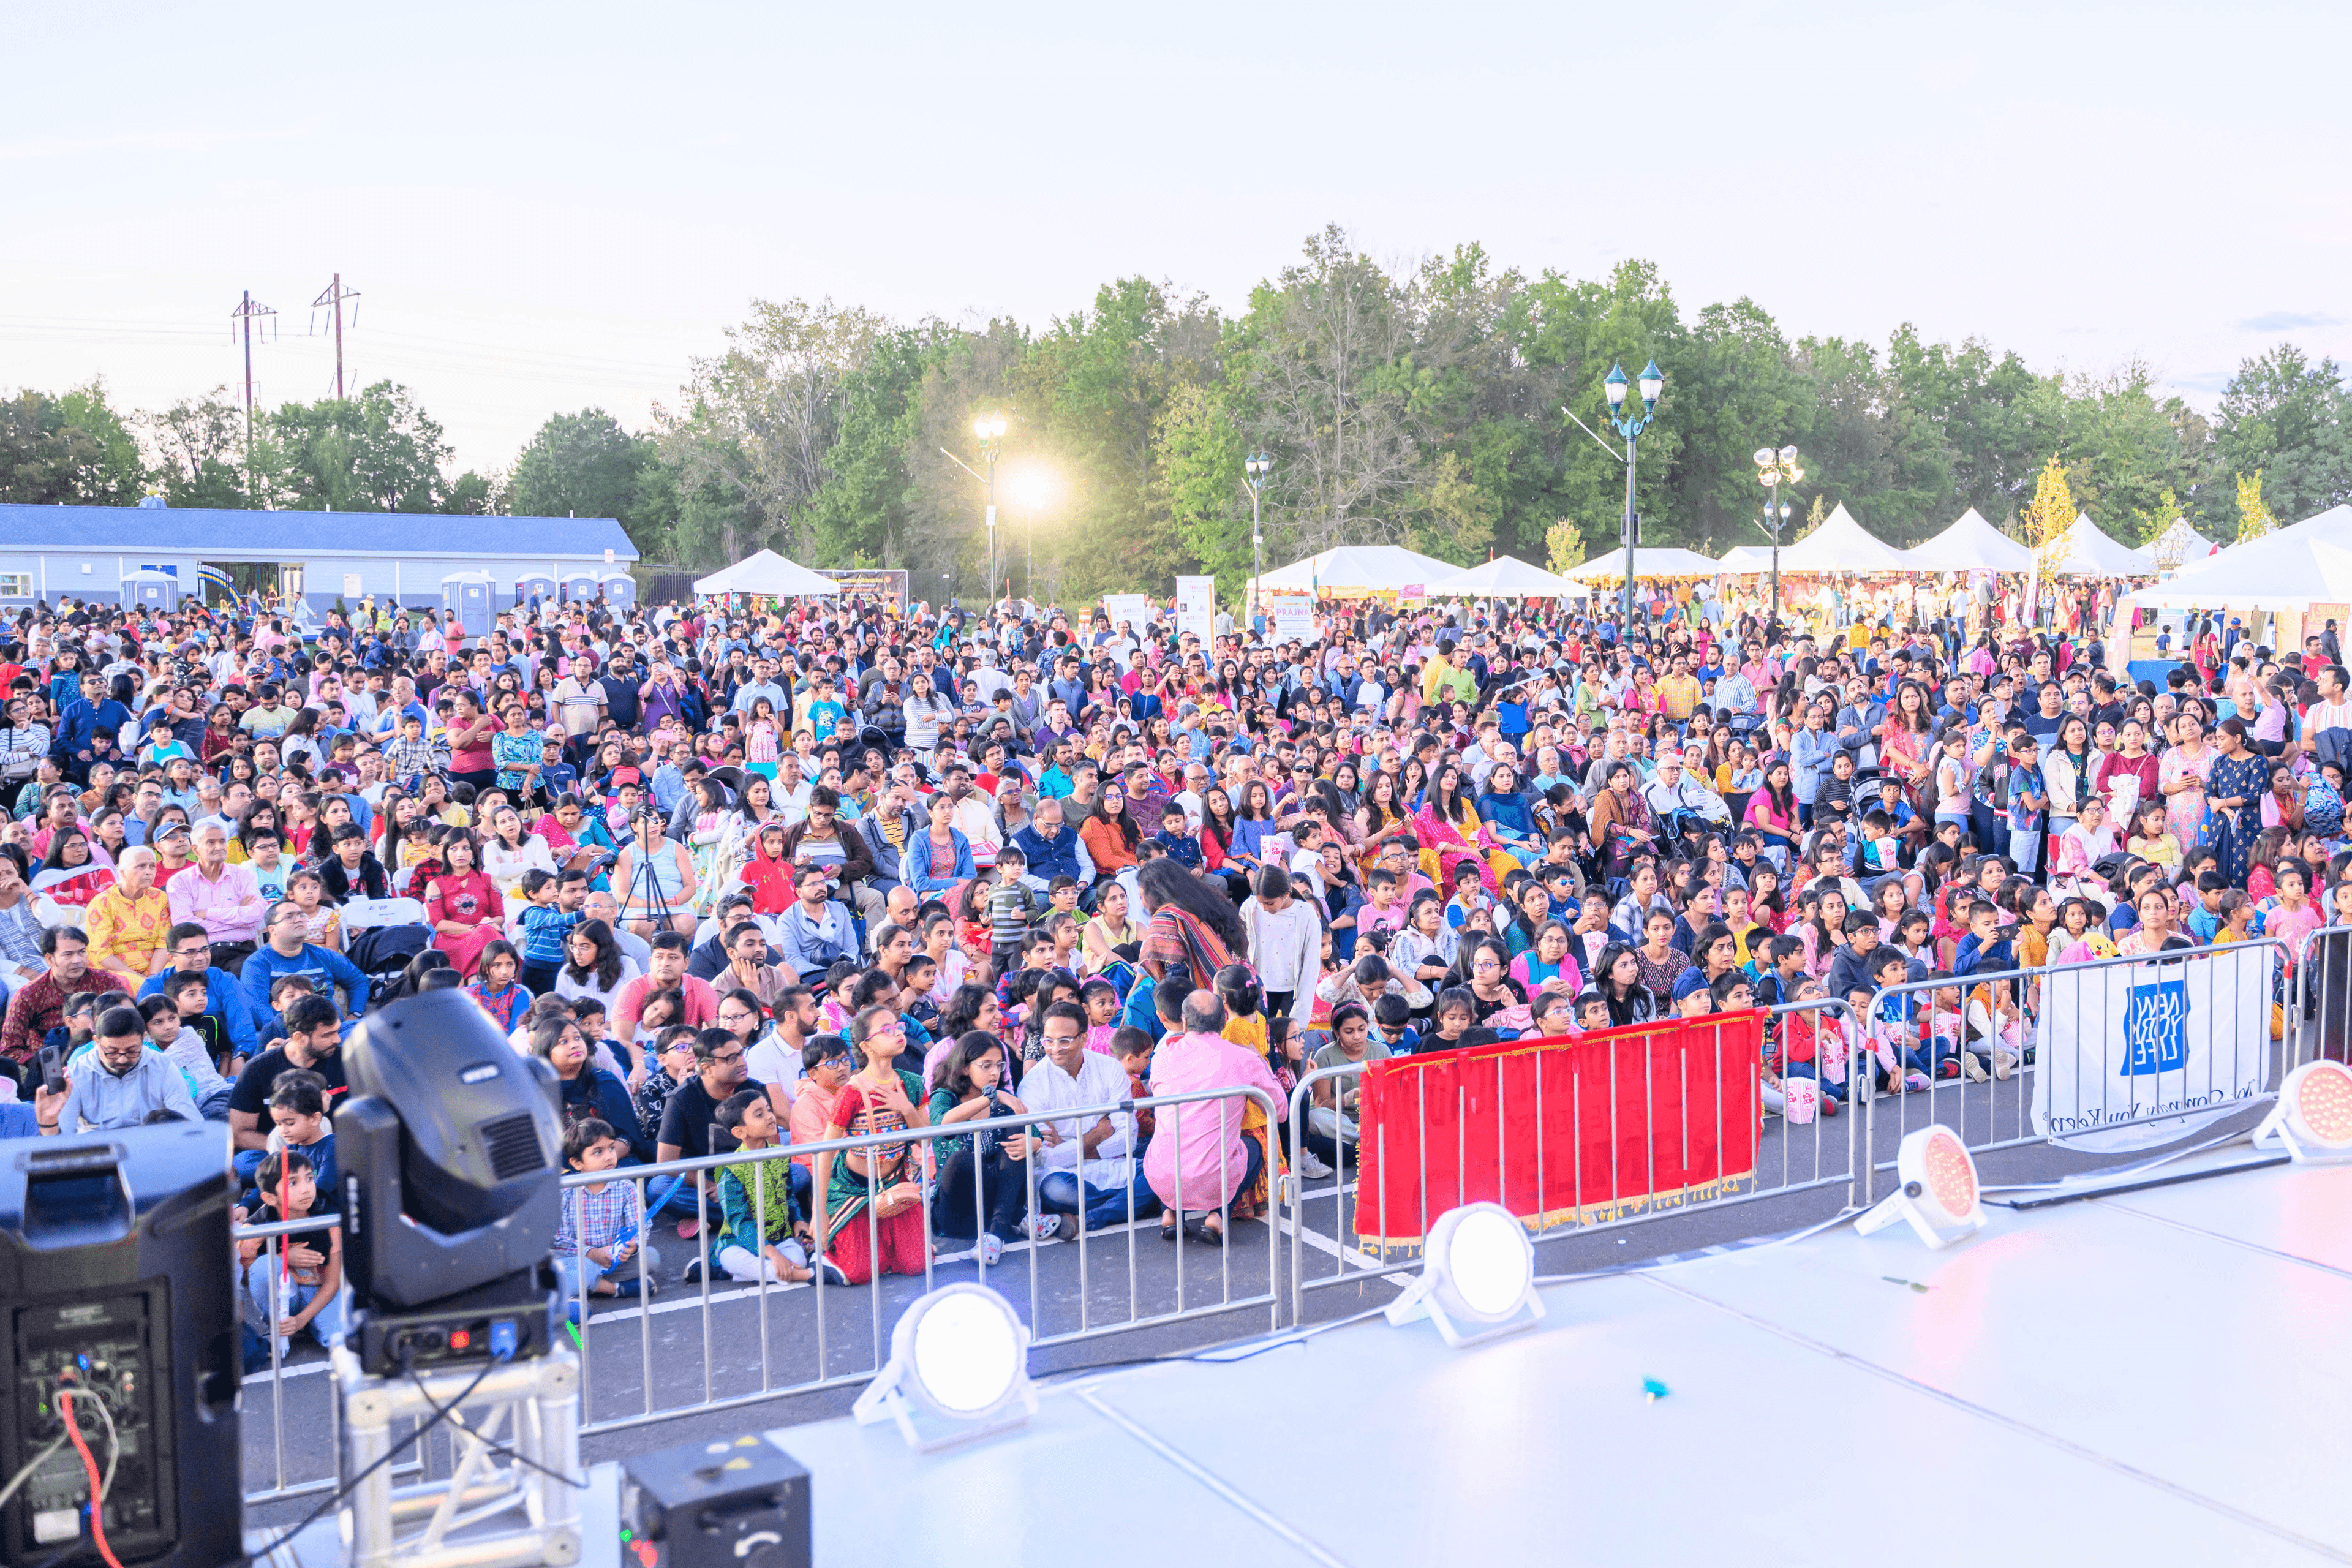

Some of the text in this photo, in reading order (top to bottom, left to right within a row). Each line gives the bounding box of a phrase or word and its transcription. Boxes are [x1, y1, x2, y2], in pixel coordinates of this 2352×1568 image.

[2316, 605, 2349, 616] SUHAG
[1994, 764, 2008, 781] BU
[1040, 782, 1046, 791] 2
